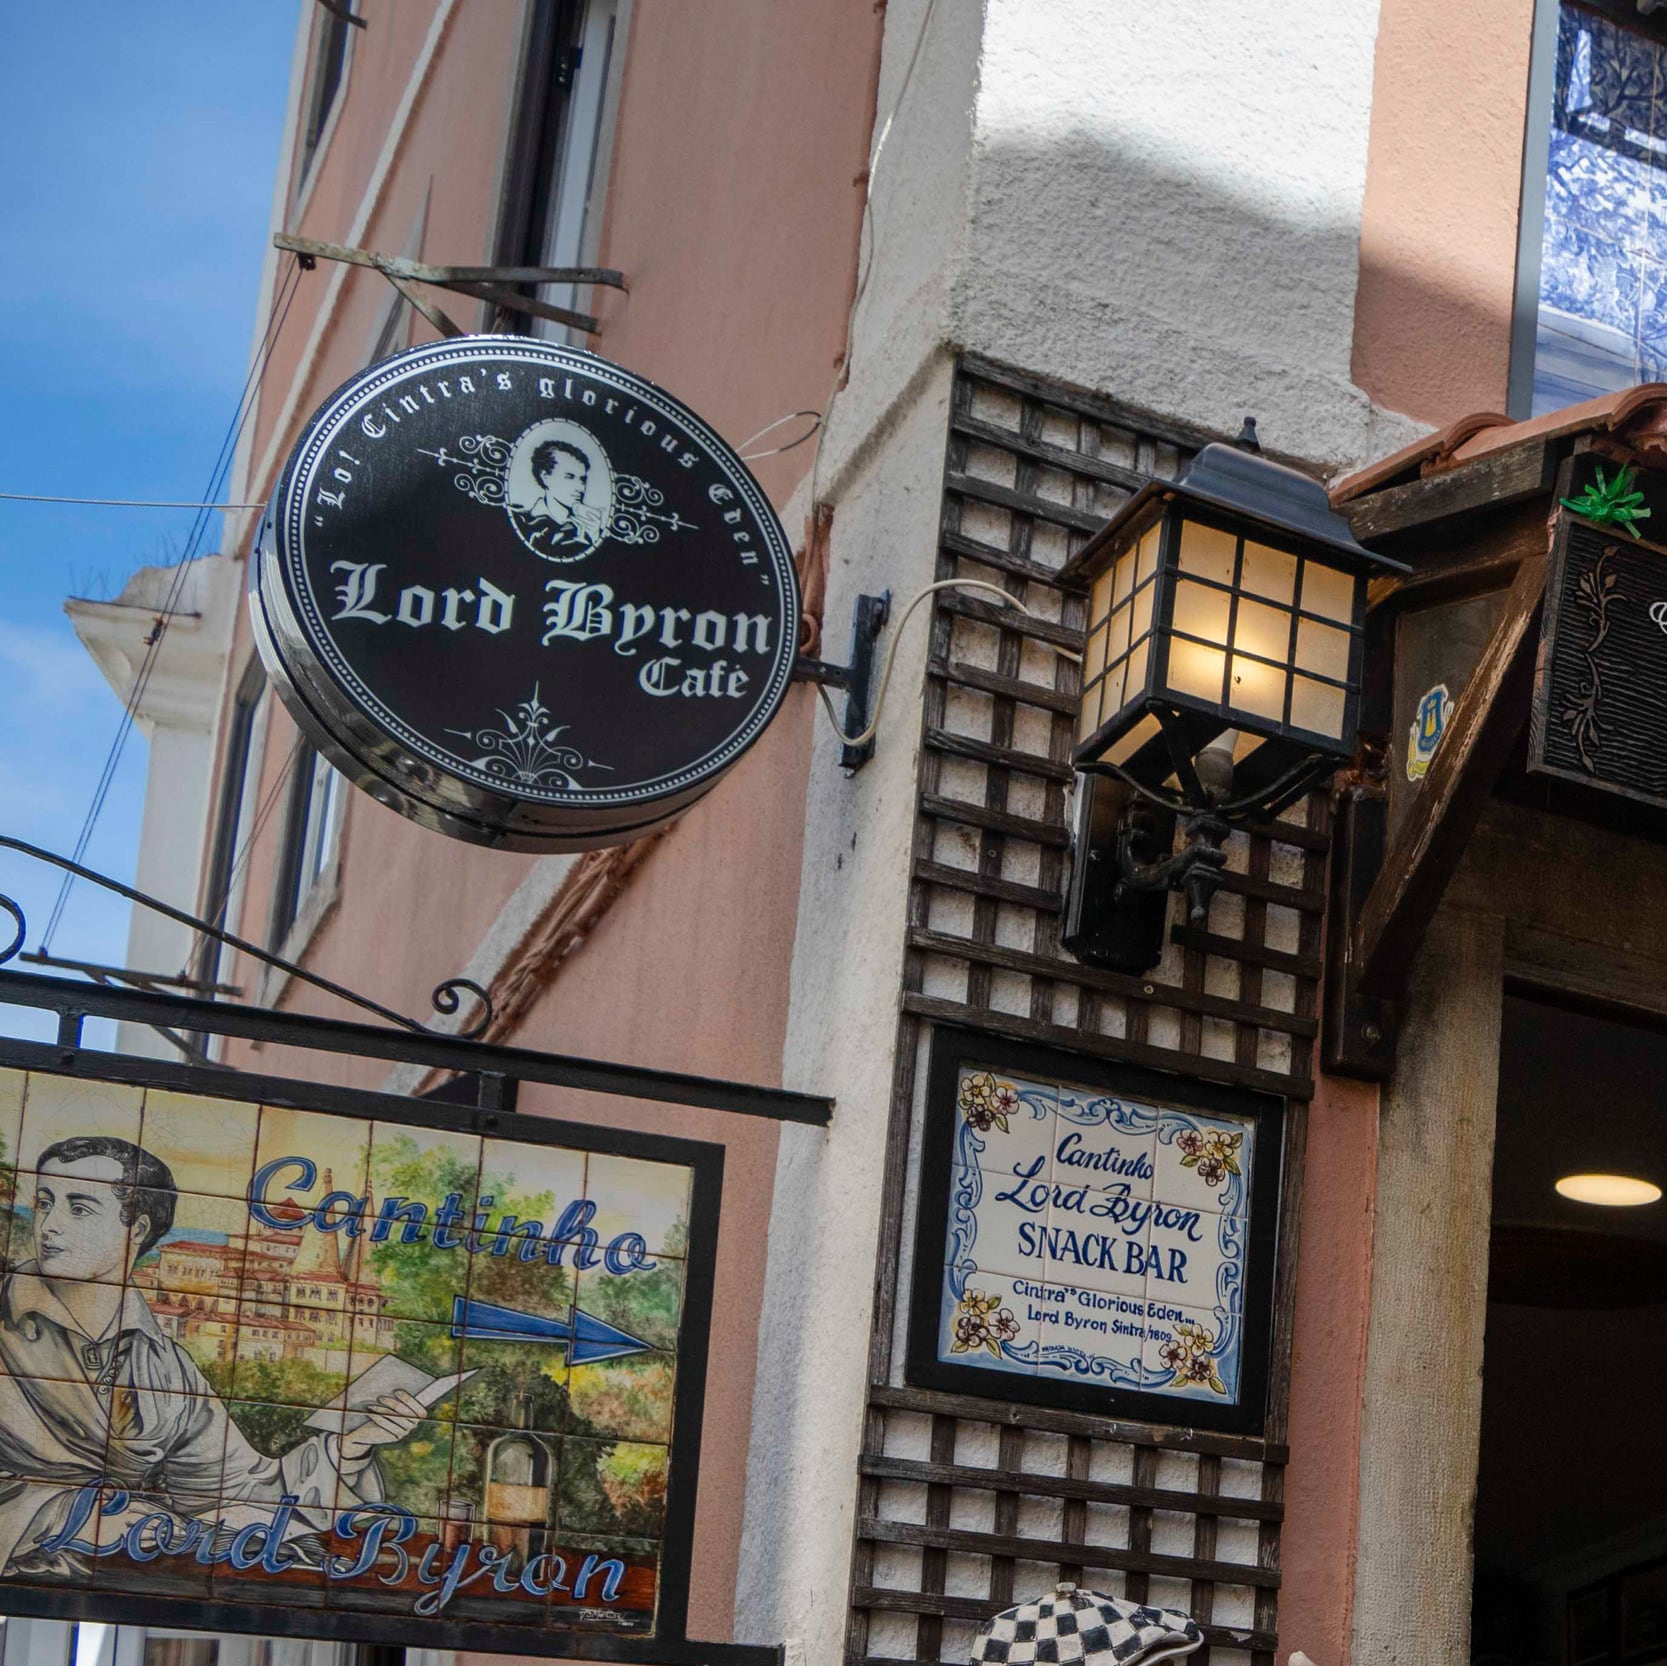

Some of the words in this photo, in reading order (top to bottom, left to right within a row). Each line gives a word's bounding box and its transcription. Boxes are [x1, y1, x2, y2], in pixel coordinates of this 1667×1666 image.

[537, 376, 700, 470] glorious
[331, 560, 516, 635] Lord
[541, 579, 773, 656] Byron
[638, 657, 751, 699] Café
[1055, 1132, 1154, 1180] Cantinho
[247, 1156, 658, 1275] Cantinho
[994, 1155, 1091, 1214] Lord
[1089, 1182, 1204, 1242] Byron
[1017, 1222, 1118, 1272] SNACK
[1125, 1240, 1189, 1284] BAR
[1027, 1304, 1060, 1325] Lord
[1064, 1311, 1108, 1335] Byron
[1077, 1290, 1145, 1317] Glorious
[40, 1477, 300, 1575] Lord
[323, 1502, 625, 1616] Byron
